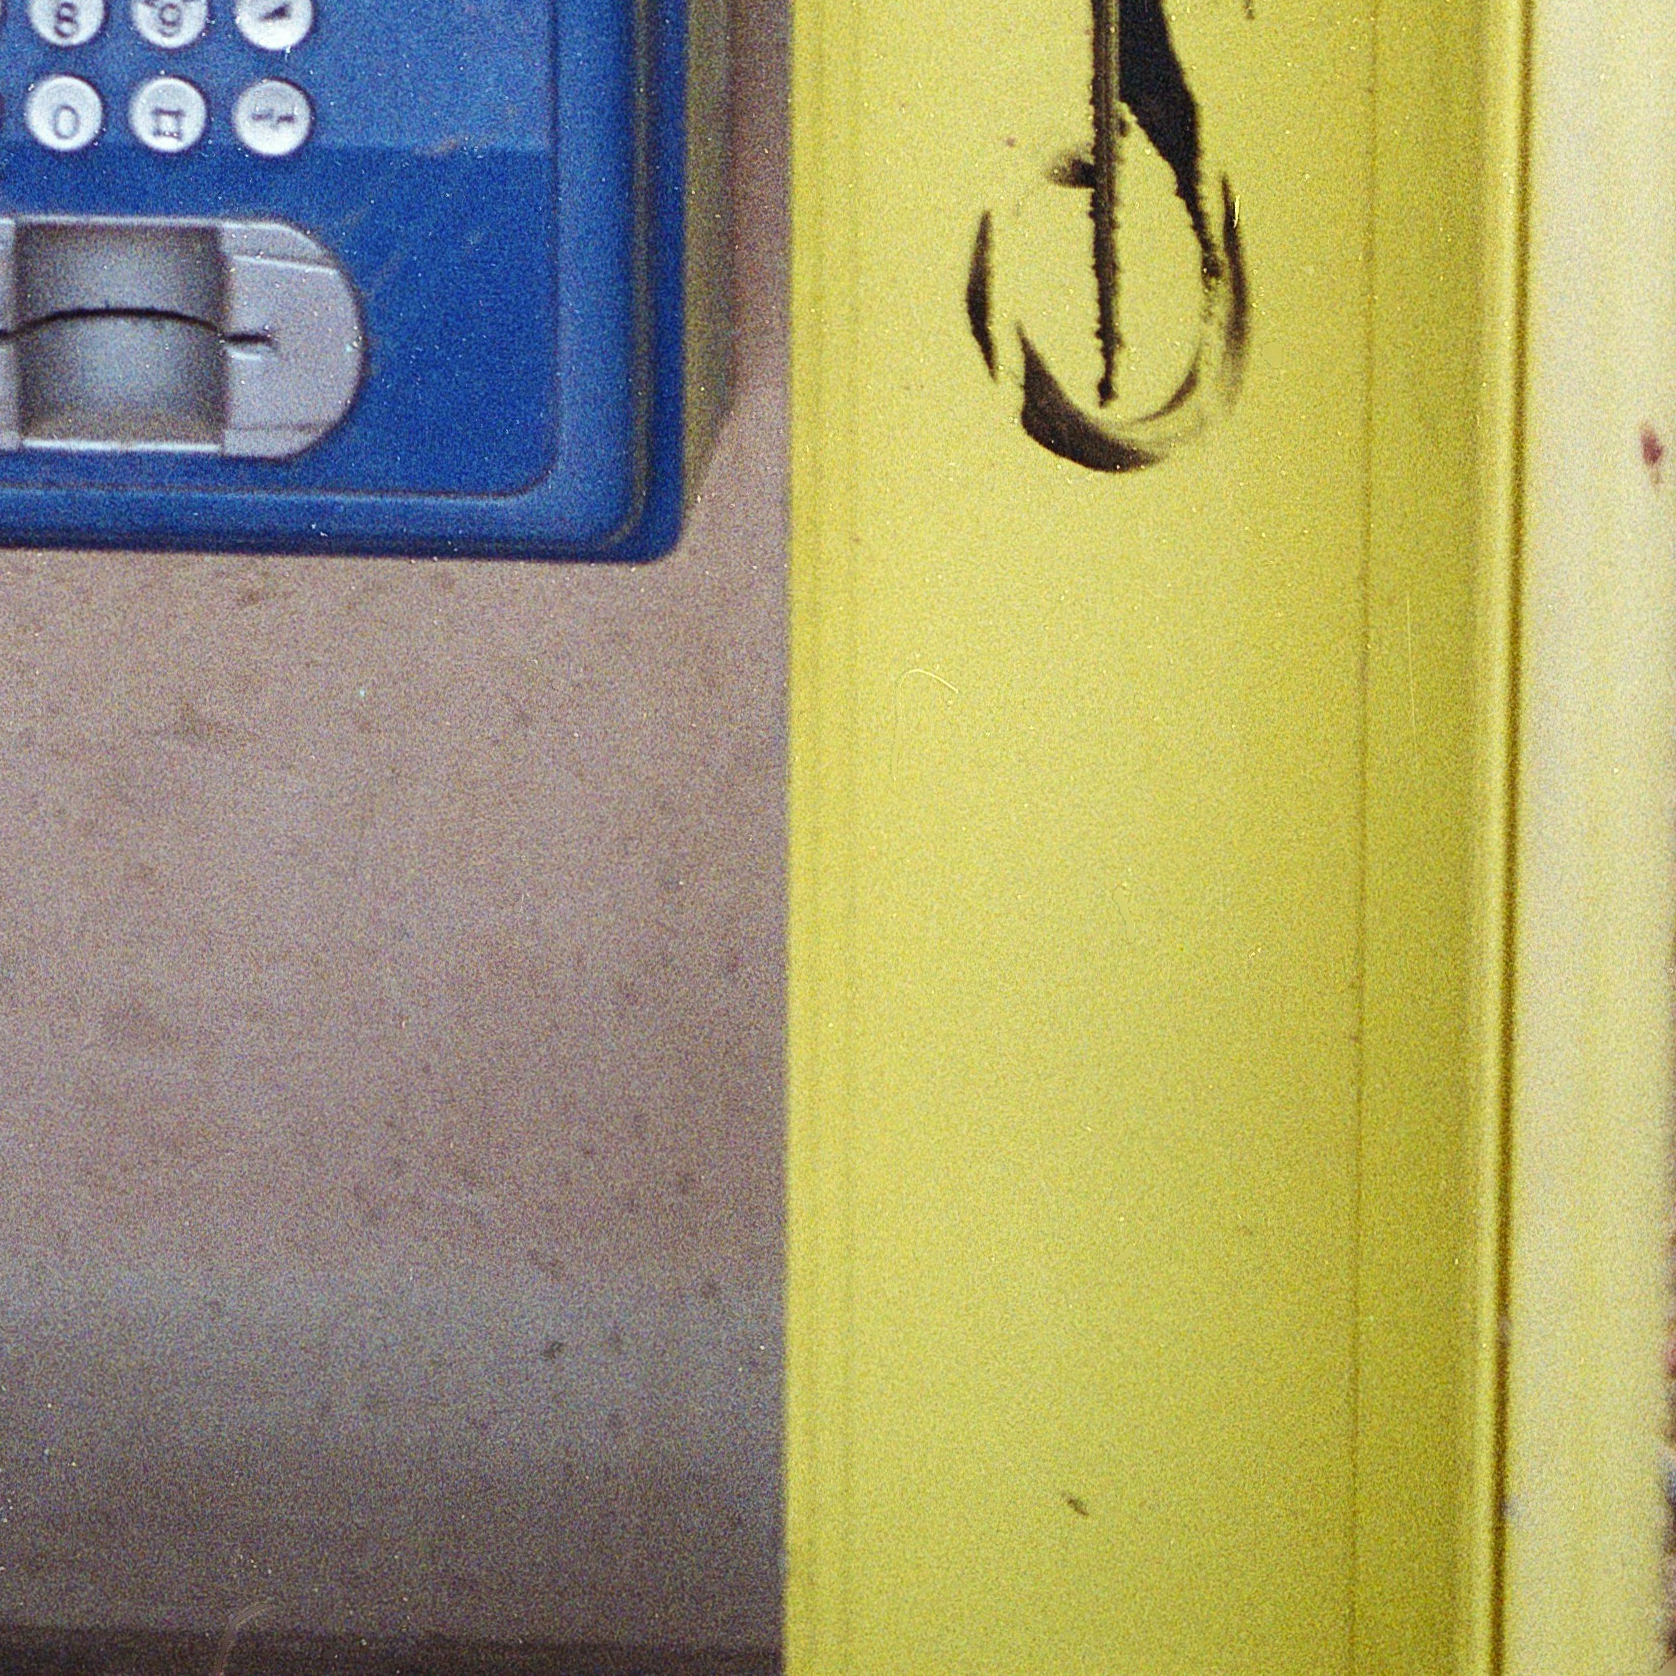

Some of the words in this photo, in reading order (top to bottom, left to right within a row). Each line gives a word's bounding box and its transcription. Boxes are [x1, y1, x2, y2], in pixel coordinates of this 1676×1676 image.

[52, 0, 79, 38] 8
[157, 1, 183, 38] 9
[52, 103, 81, 140] 0
